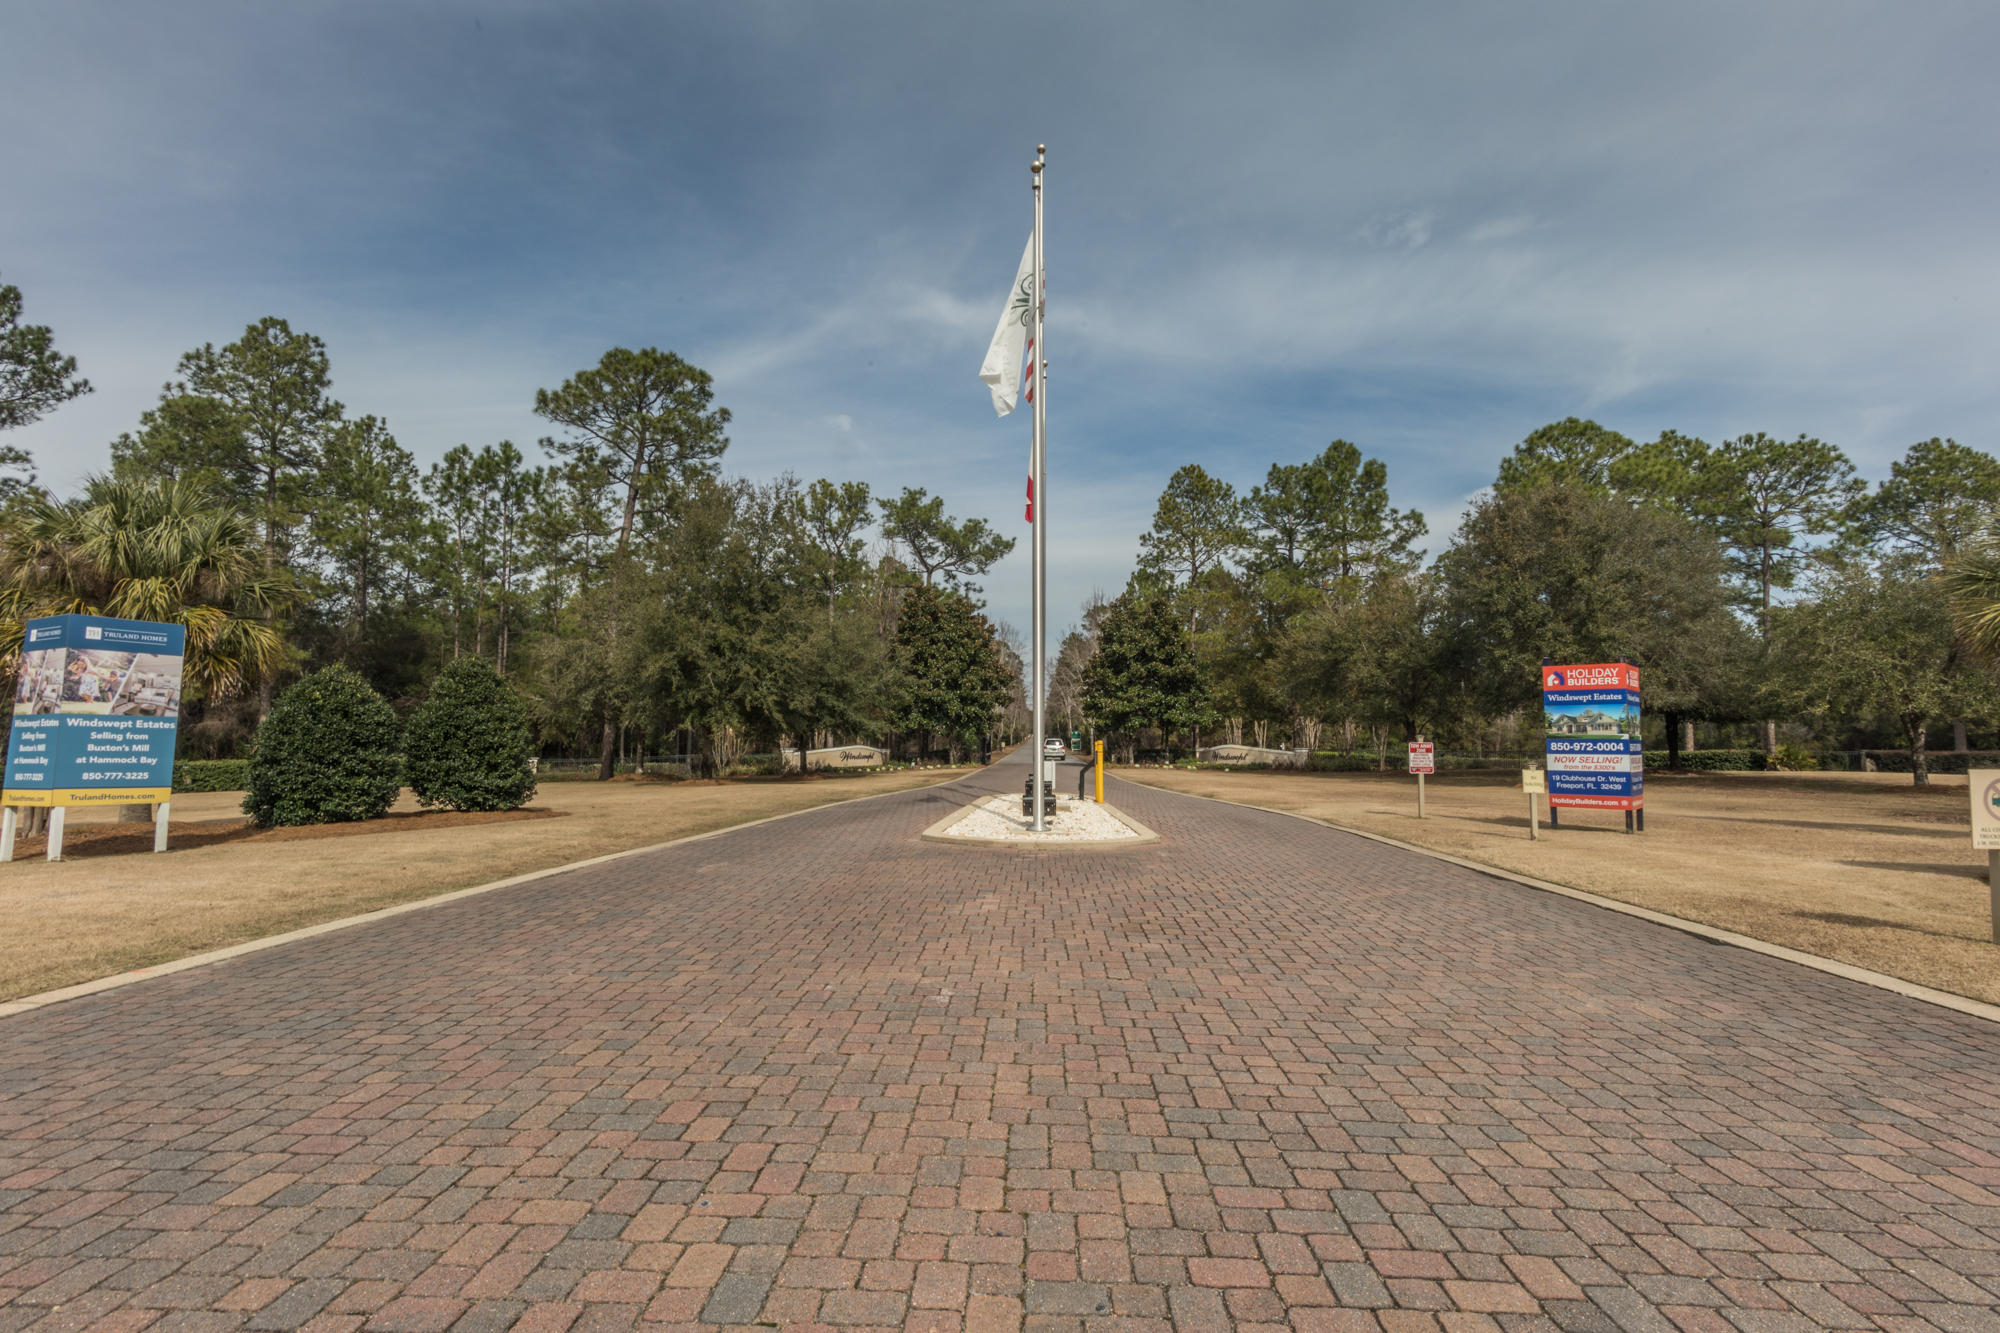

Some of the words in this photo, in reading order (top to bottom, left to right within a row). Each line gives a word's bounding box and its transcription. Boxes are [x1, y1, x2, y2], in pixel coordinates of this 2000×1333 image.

[104, 631, 139, 641] TRULAND
[141, 635, 168, 643] HOMES
[1568, 668, 1619, 678] HOLIDAY
[1568, 677, 1619, 686] BUILDERS
[1548, 694, 1592, 702] Windswept
[1594, 693, 1622, 701] Estates
[67, 717, 133, 729] Windswept
[135, 719, 175, 729] Estates
[90, 732, 124, 741] Selling
[126, 732, 148, 740] from
[87, 743, 129, 752] Buxton's
[132, 743, 150, 752] Mill
[1551, 743, 1624, 751] 850-972-0004
[89, 756, 138, 764] Hammock
[140, 756, 157, 766] Bay
[1579, 756, 1623, 764] SELLING!
[82, 772, 149, 780] 850-777-3225
[70, 793, 155, 801] TrulandHomes.com
[1552, 797, 1618, 806] HolidayBuilders.com
